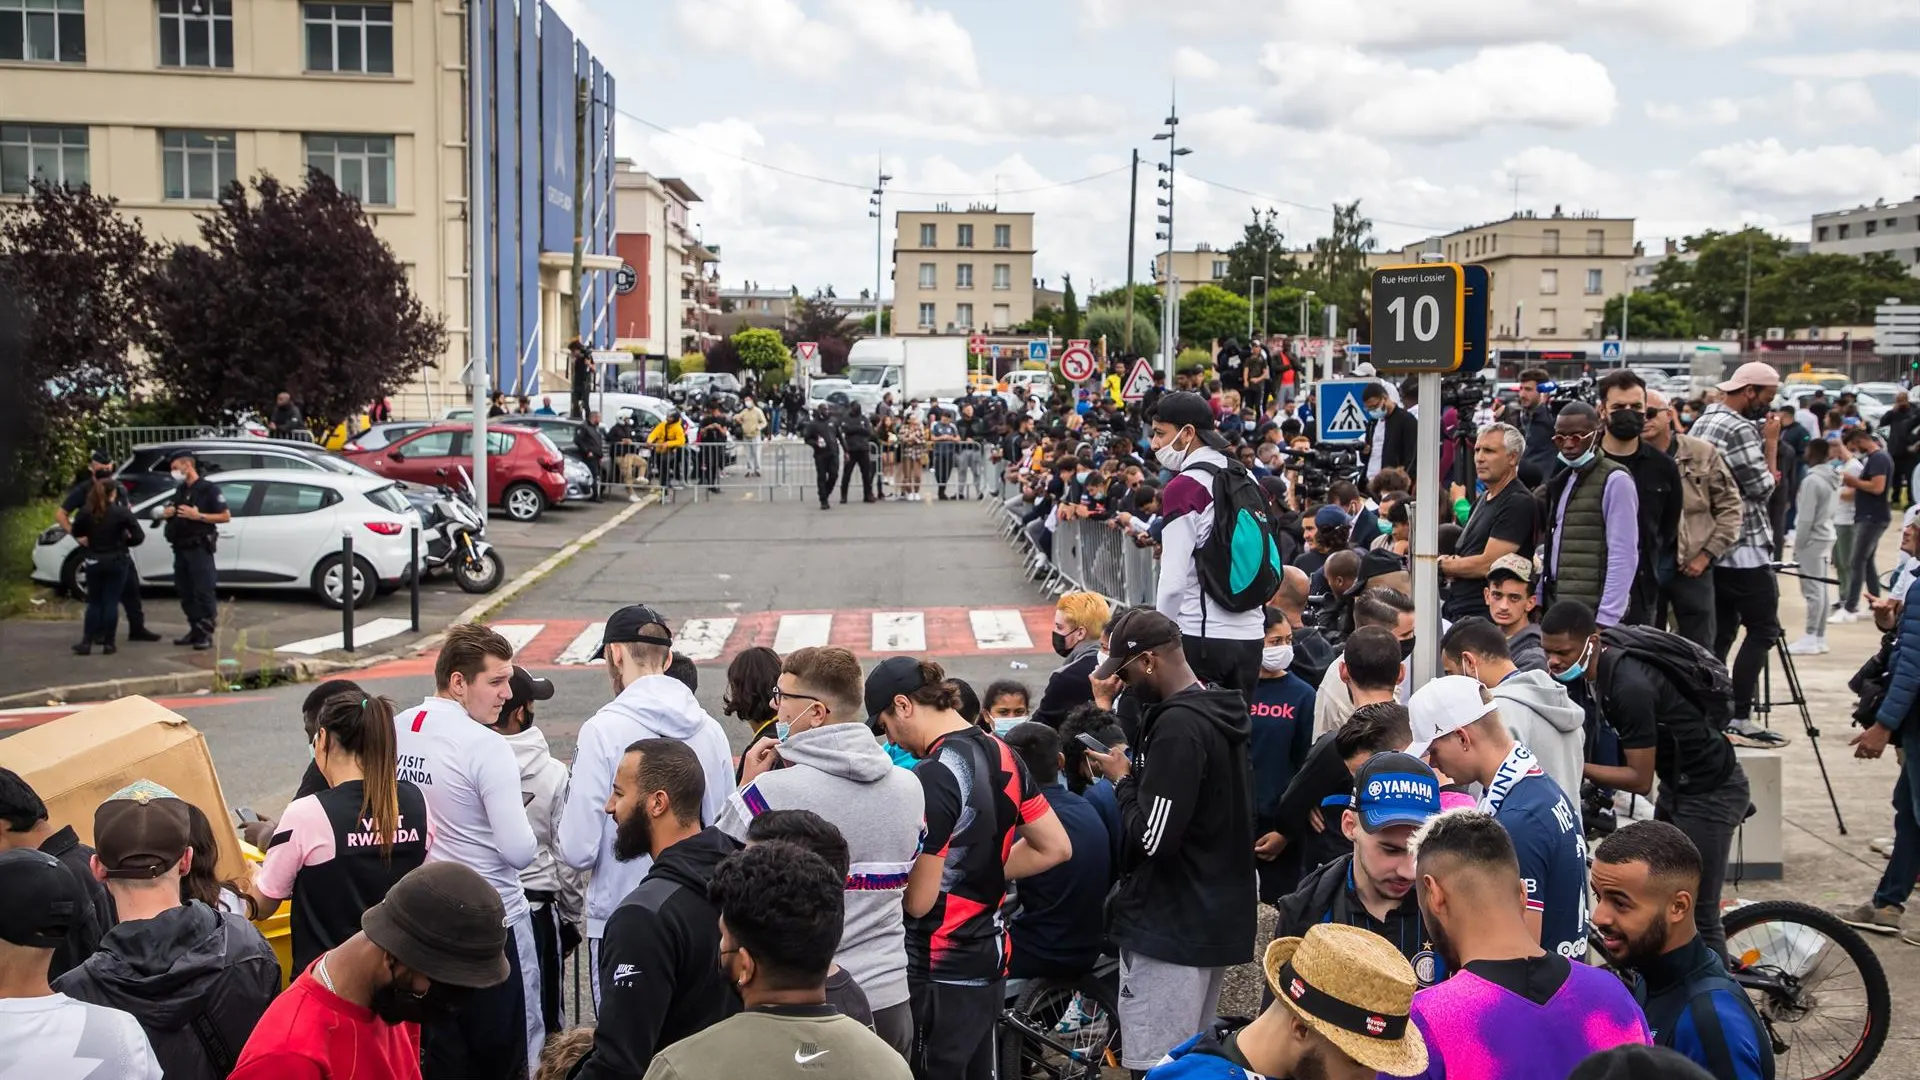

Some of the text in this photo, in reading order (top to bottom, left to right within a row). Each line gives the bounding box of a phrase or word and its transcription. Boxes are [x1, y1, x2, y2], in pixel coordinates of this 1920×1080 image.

[1381, 273, 1446, 284] Rue Henri Lossier
[1387, 294, 1440, 342] 10
[1250, 702, 1295, 719] ebok
[397, 769, 433, 785] ANDA
[1490, 747, 1530, 813] AINT-G
[1382, 780, 1433, 799] YAMAHA
[1374, 794, 1431, 803] RACING
